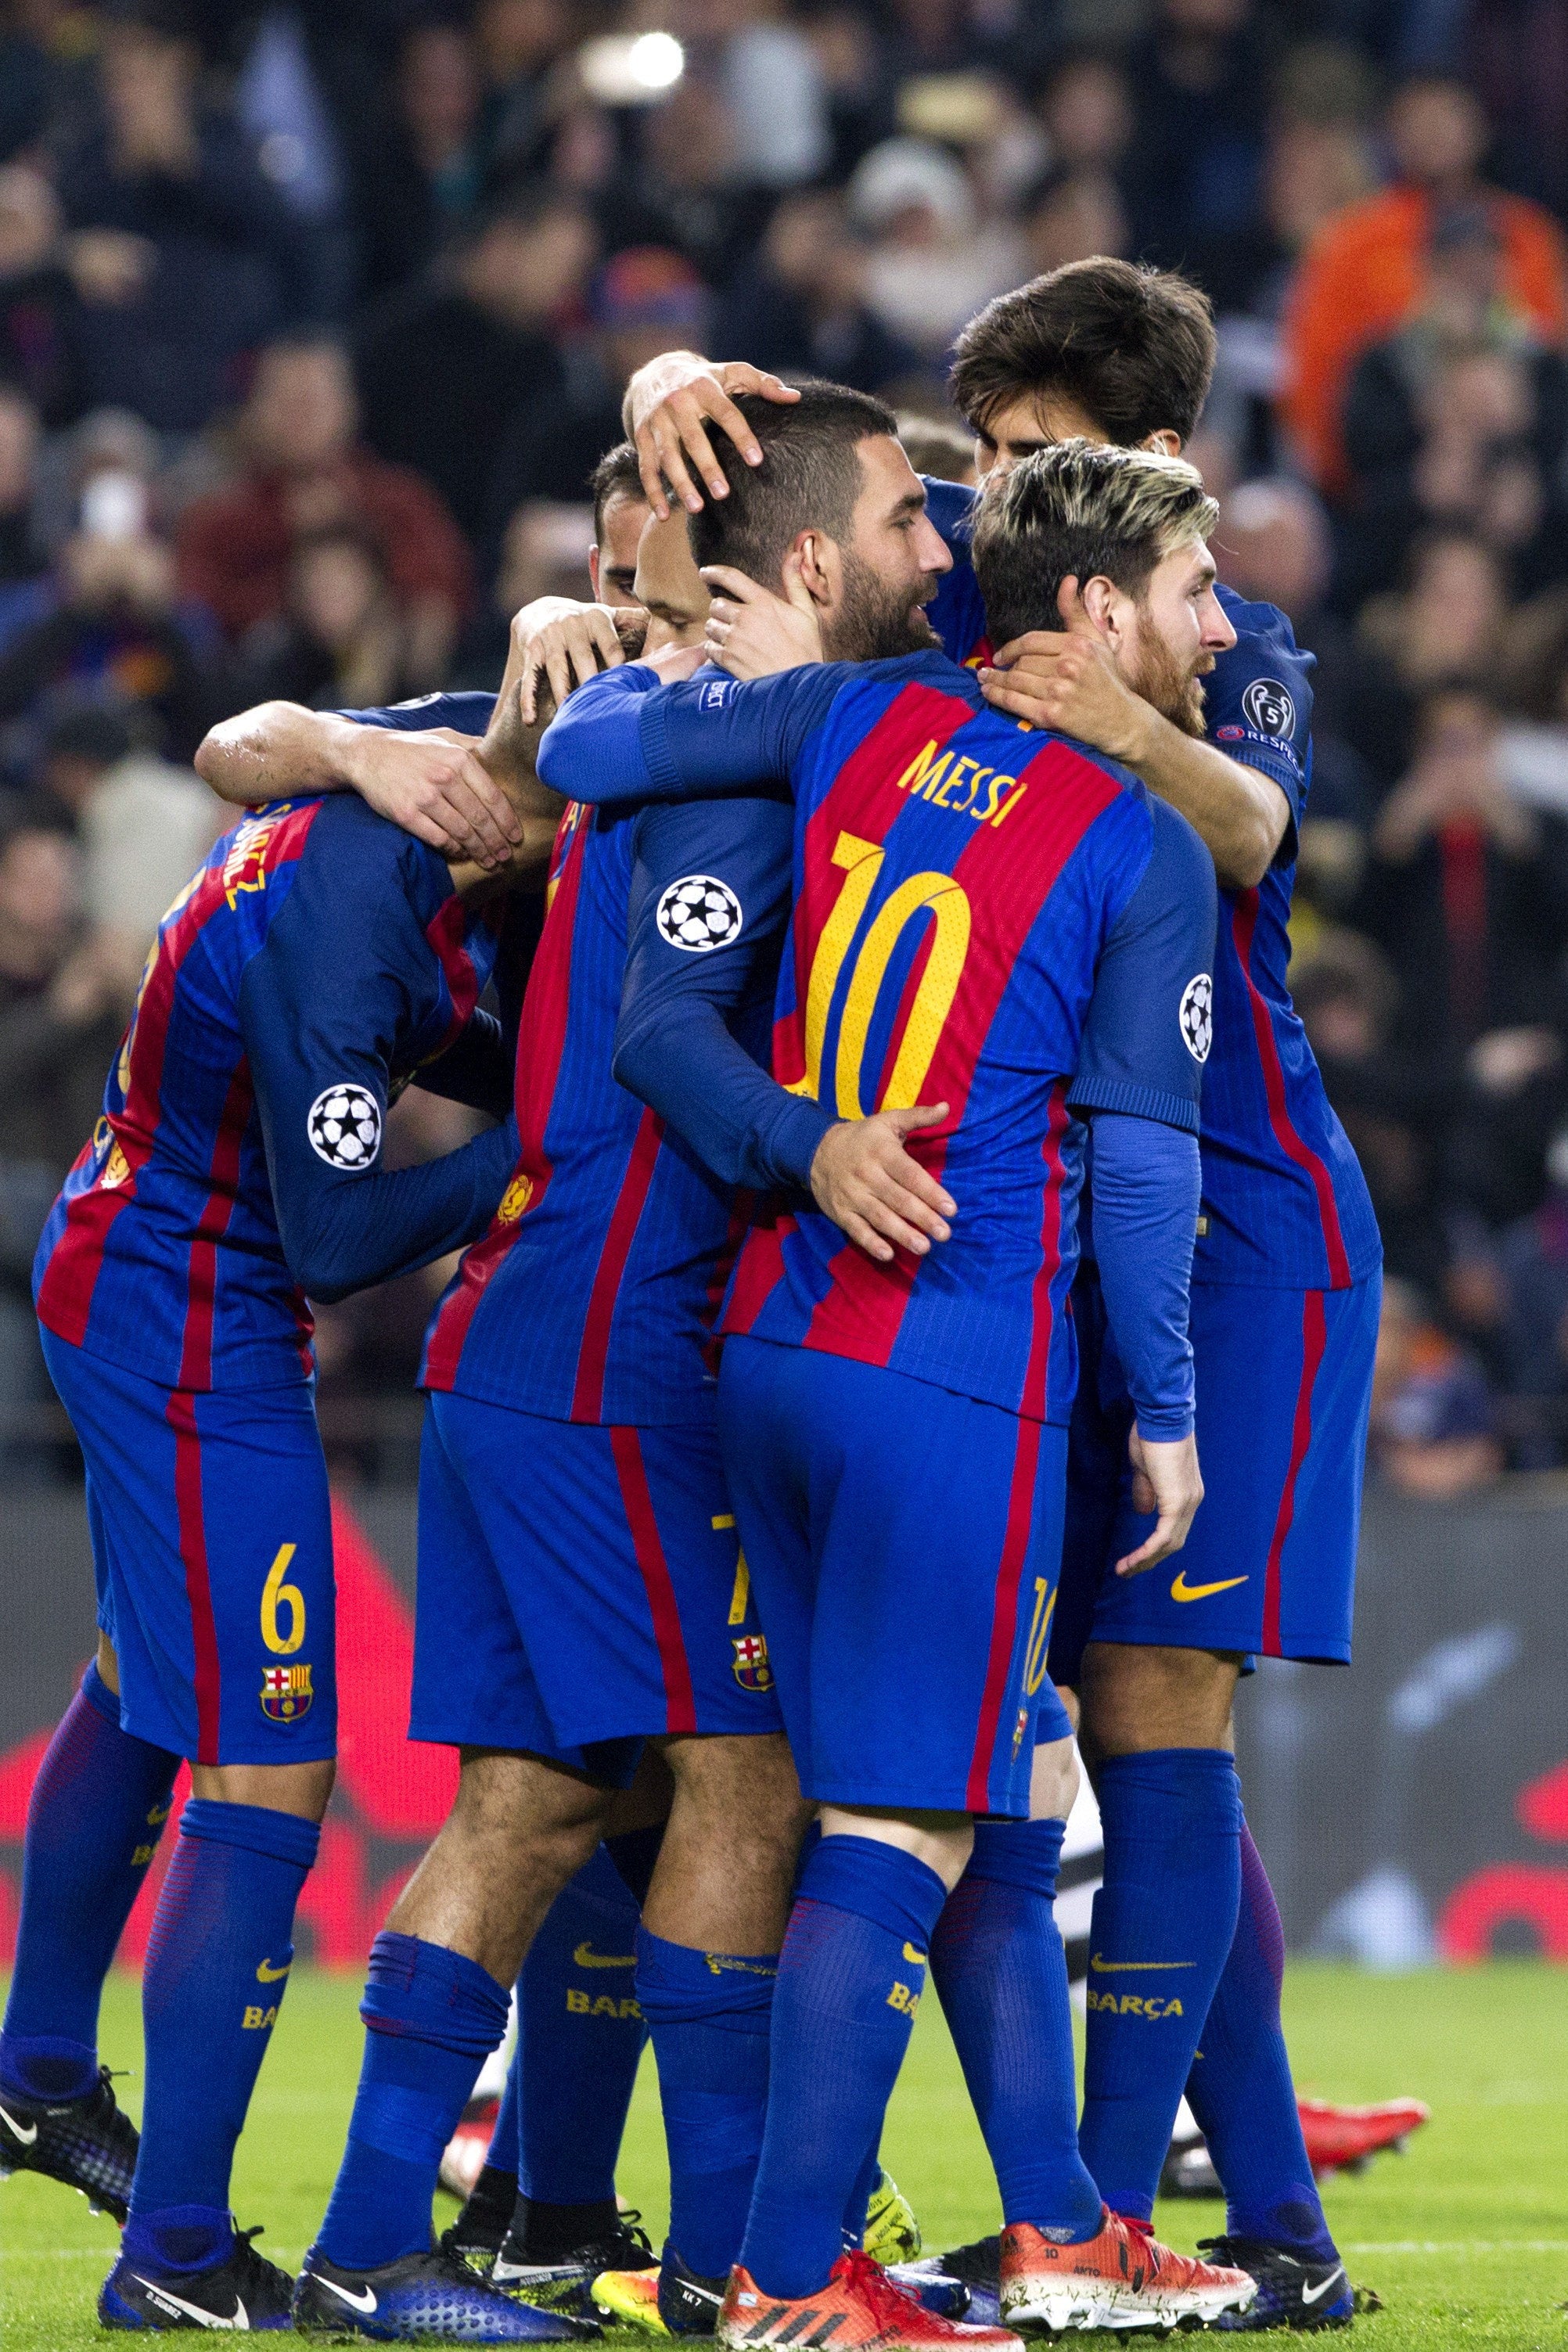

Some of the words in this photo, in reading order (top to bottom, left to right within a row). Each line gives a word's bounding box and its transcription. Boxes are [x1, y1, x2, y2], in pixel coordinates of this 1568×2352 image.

[1265, 707, 1279, 725] 5
[897, 739, 1029, 828] MESSI
[781, 829, 972, 1121] 10
[260, 1542, 307, 1655] 6
